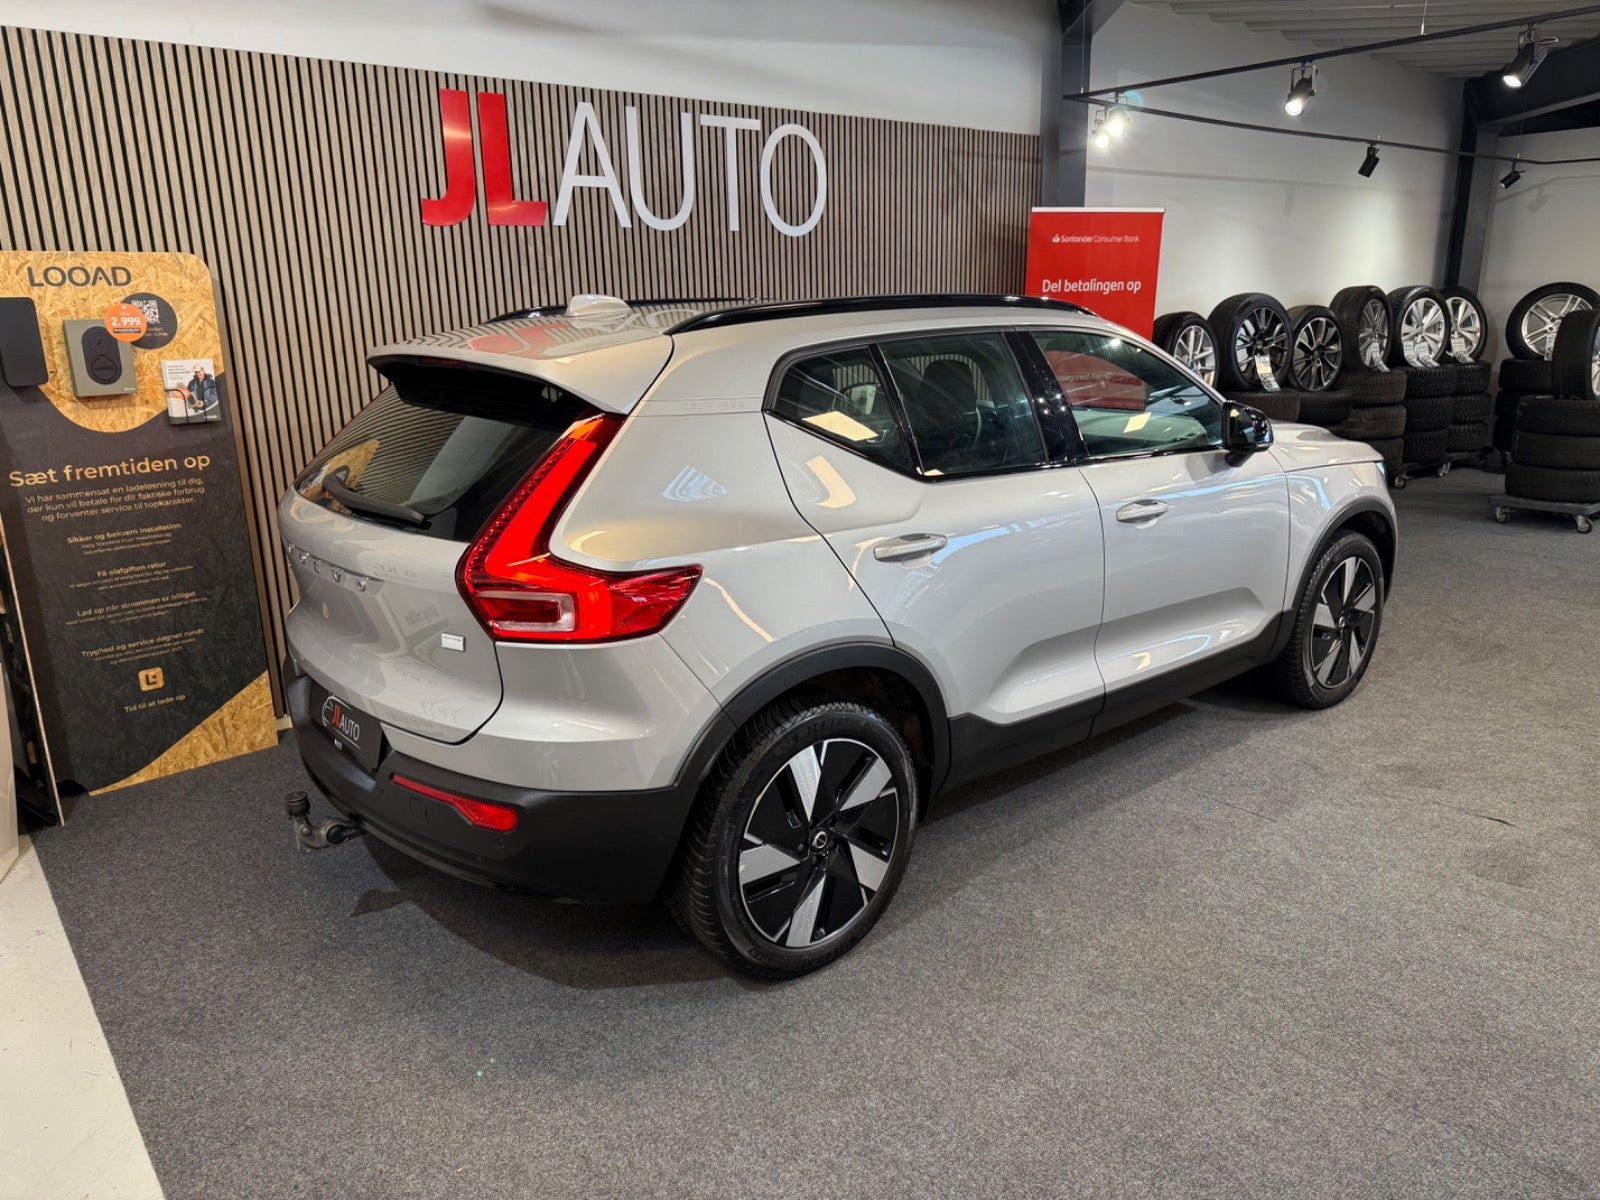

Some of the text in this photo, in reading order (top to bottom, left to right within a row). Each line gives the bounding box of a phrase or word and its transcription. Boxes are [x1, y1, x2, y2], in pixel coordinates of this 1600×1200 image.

[1060, 234, 1139, 243] Santander Consumer Bank
[1042, 279, 1142, 295] Del betalingen op
[8, 455, 210, 487] Sæt fremtiden op
[25, 495, 35, 504] Vi
[37, 494, 53, 503] har
[55, 487, 110, 500] sammensat
[27, 505, 43, 513] der
[45, 503, 64, 511] kun
[66, 500, 77, 508] vil
[79, 497, 108, 507] betale
[124, 494, 136, 502] dit
[138, 490, 172, 500] faktiske
[173, 486, 205, 497] forbrug
[41, 514, 54, 523] og
[57, 508, 98, 520] forventer
[101, 504, 132, 514] service
[133, 502, 143, 510] til
